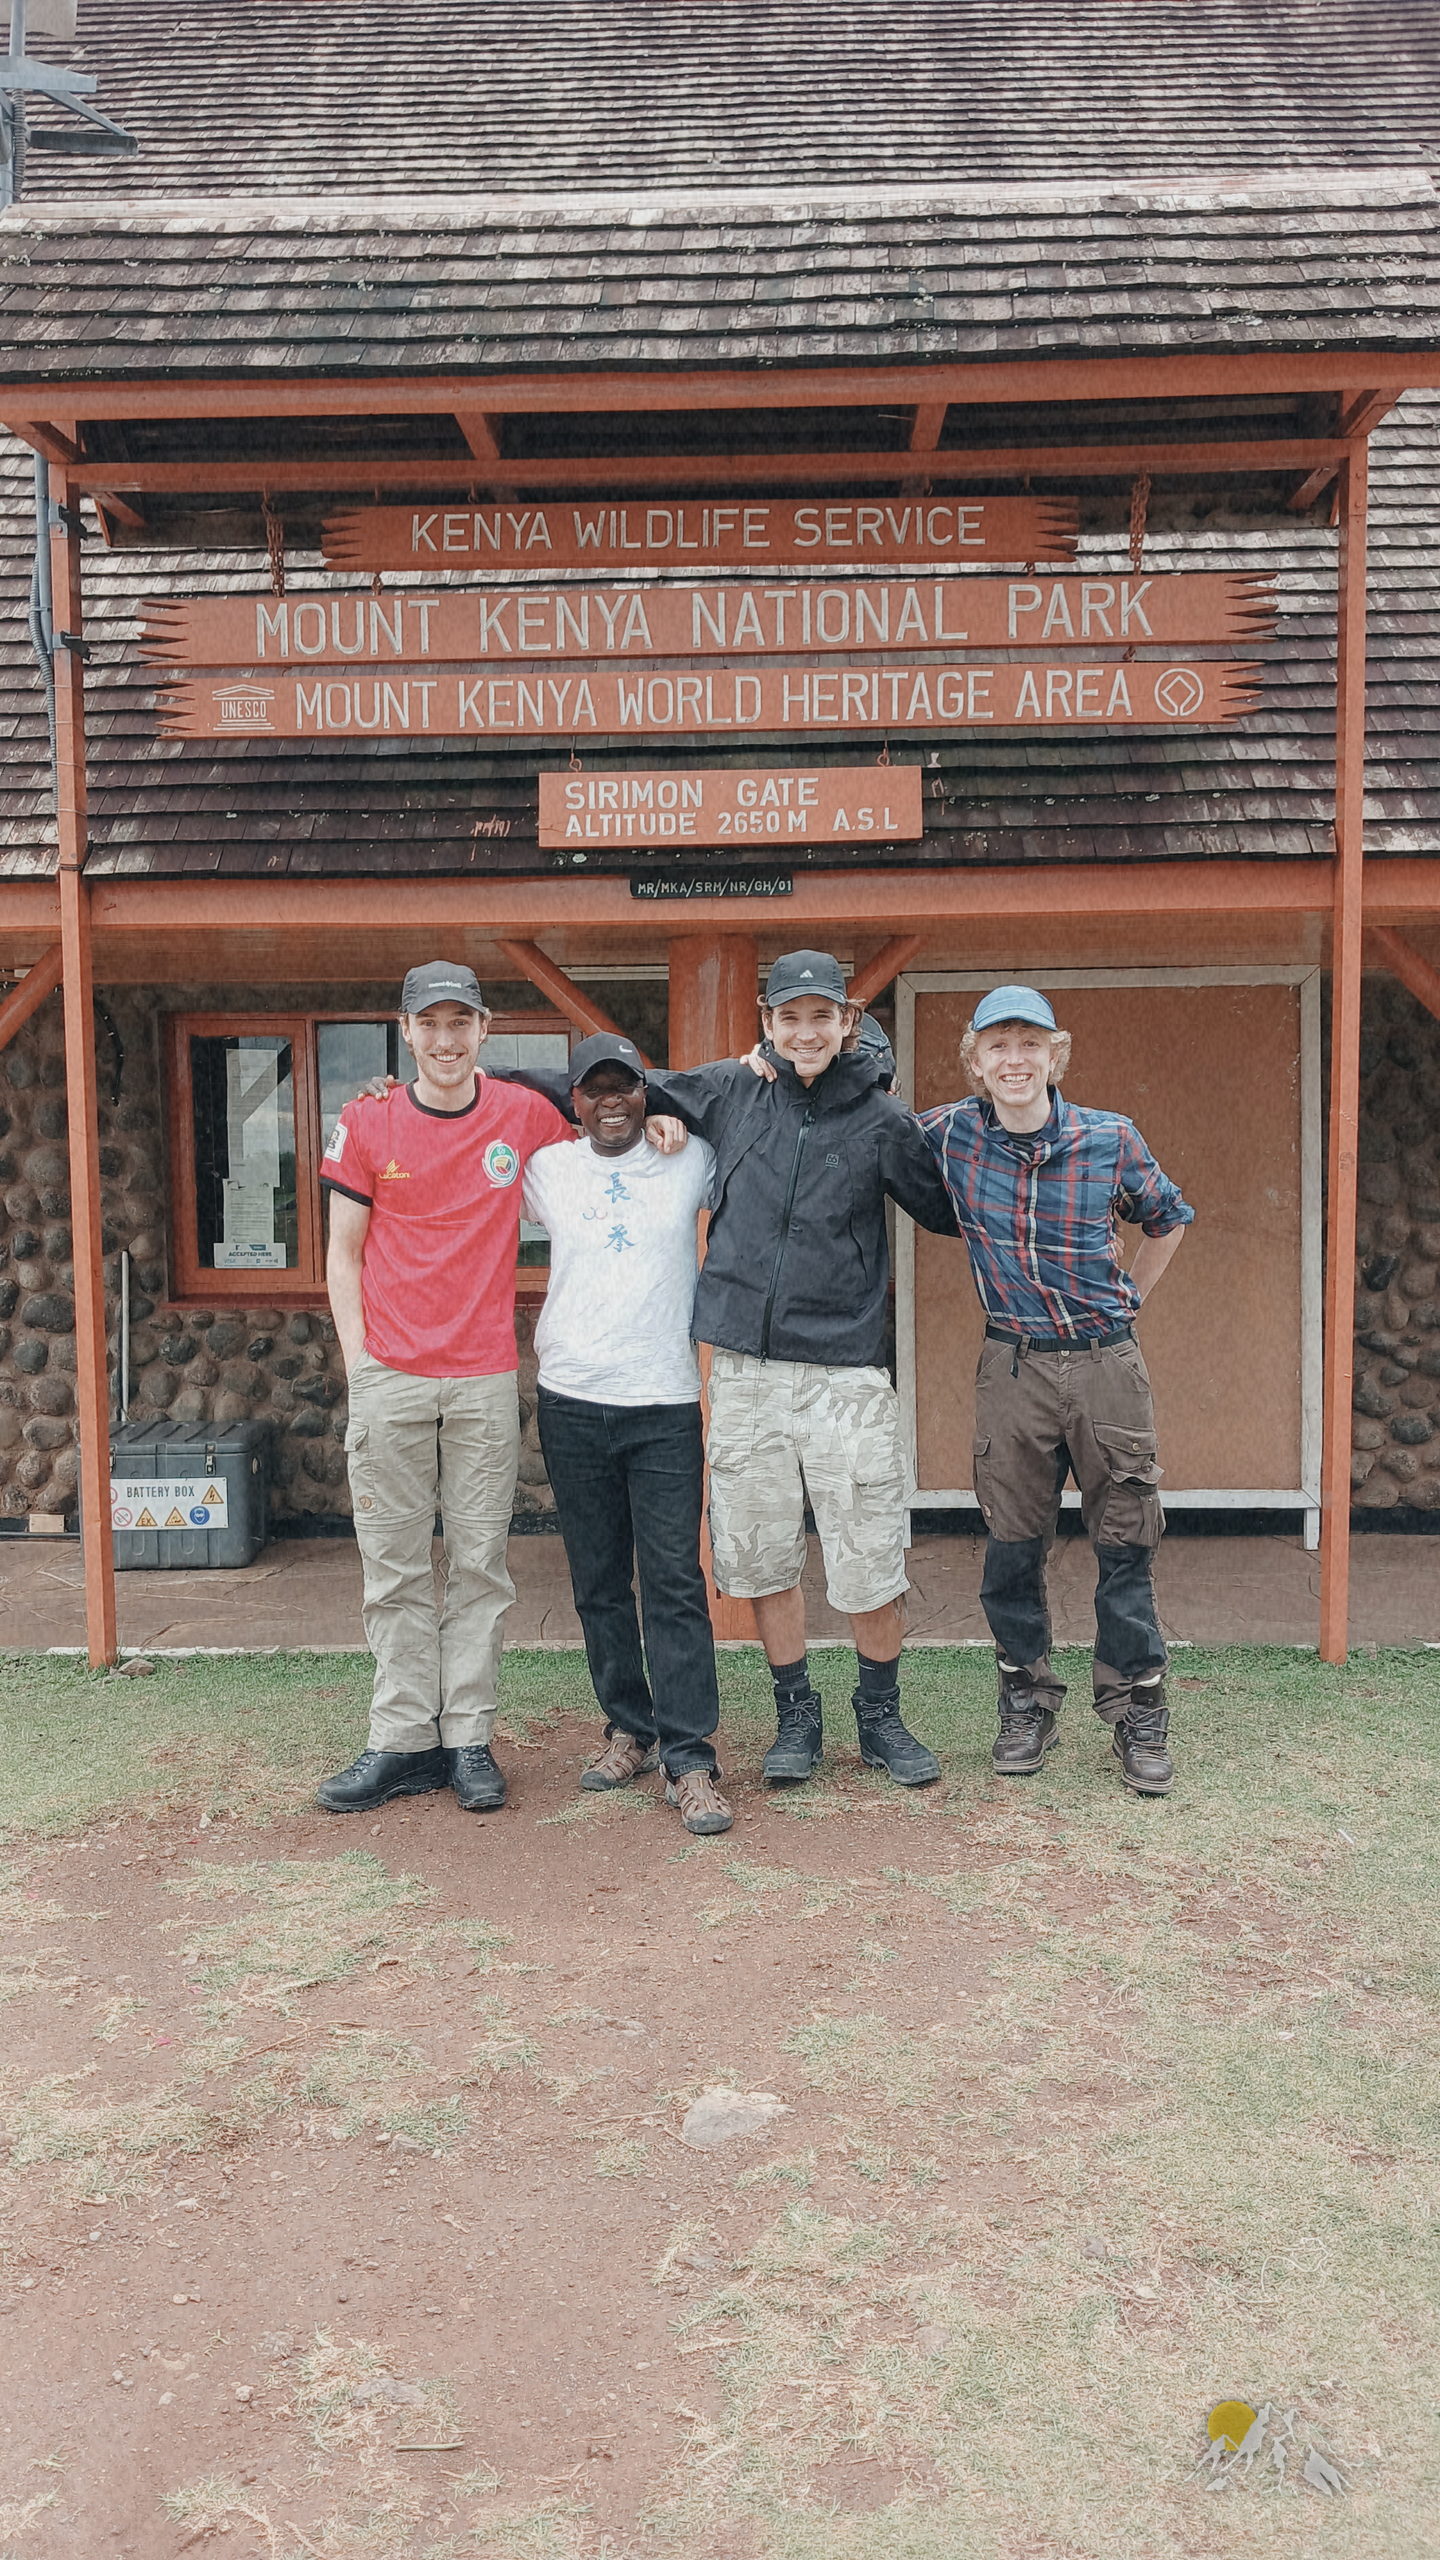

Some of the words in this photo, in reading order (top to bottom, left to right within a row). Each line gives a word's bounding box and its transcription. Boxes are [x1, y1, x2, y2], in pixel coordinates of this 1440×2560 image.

[411, 509, 553, 553] KENYA
[573, 507, 771, 552] WILDLIFE
[793, 505, 986, 548] SERVICE
[256, 600, 440, 658] MOUNT
[480, 594, 654, 655] KENYA
[692, 585, 969, 648] NATIONAL
[1008, 580, 1155, 639] PARK
[221, 700, 267, 719] UNESCO
[295, 681, 438, 731] MOUNT
[458, 679, 598, 728] KENYA
[617, 676, 762, 726] WORLD
[783, 669, 995, 723] HERITAGE
[1014, 669, 1134, 719] AREA
[564, 779, 704, 810] SIRIMON
[737, 777, 820, 808] GATE
[564, 812, 697, 839] ALTITUDE
[832, 806, 899, 832] A.S.L
[637, 876, 792, 898] MR/MKA/SRM/NR/GH/01
[126, 1485, 171, 1498] BATTERY
[174, 1485, 196, 1498] BOX
[141, 1517, 152, 1526] EX
